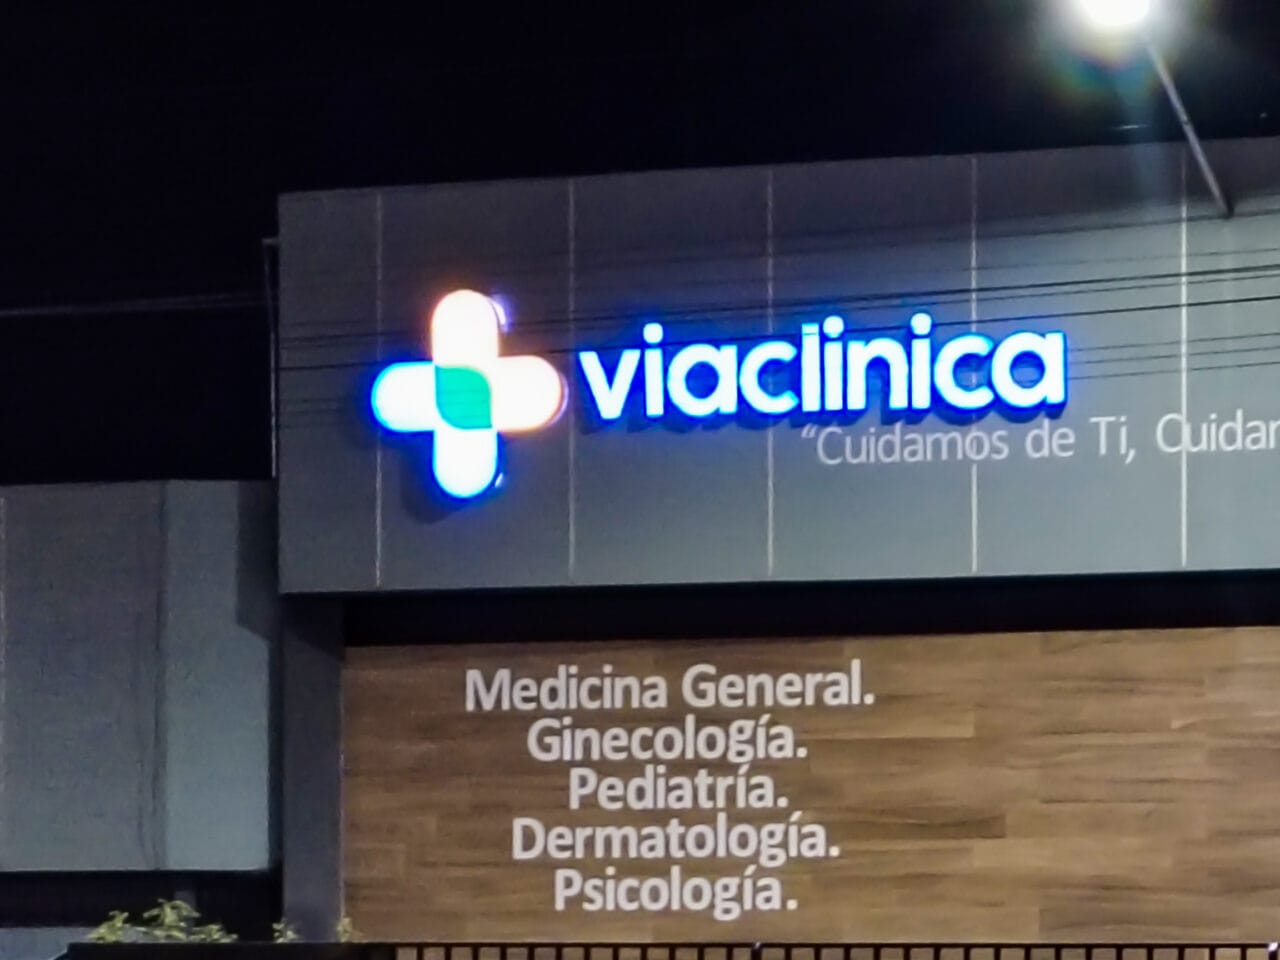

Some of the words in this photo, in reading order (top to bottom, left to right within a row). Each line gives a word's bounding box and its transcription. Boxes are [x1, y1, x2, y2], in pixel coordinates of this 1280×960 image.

[580, 311, 1066, 422] viaclinica
[1025, 419, 1075, 459] de
[1090, 415, 1136, 464] Ti,
[464, 664, 668, 713] Medicina
[681, 659, 876, 709] General.
[526, 713, 809, 764] Ginecología.
[568, 763, 790, 811] Pediatría.
[511, 811, 841, 868] Dermatología.
[554, 865, 799, 922] Psicología.
